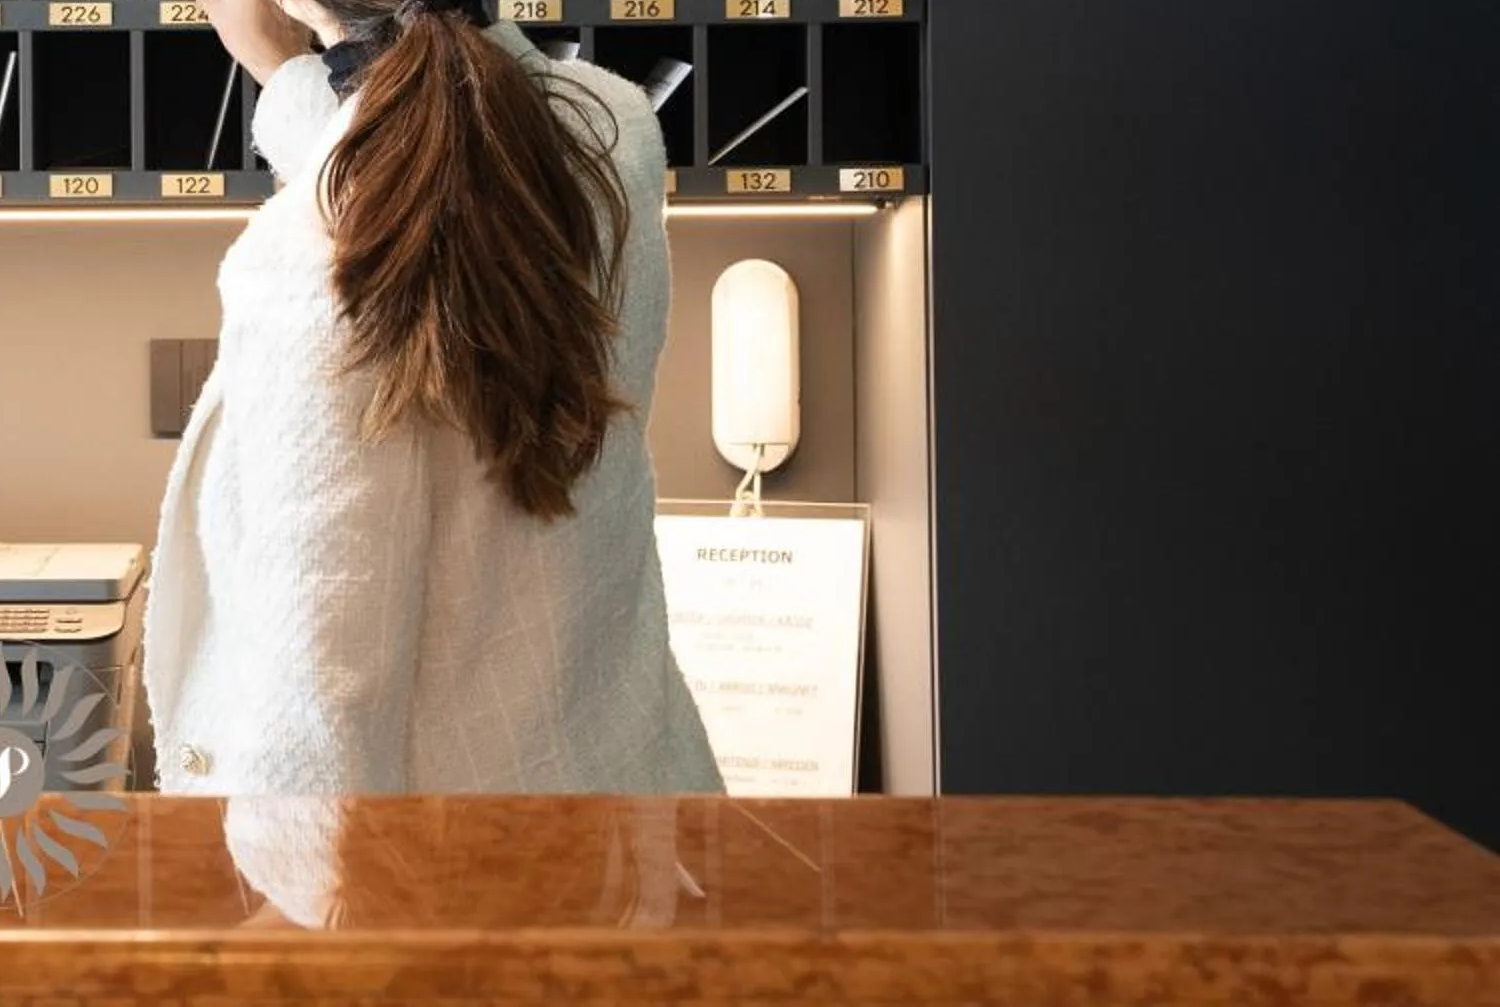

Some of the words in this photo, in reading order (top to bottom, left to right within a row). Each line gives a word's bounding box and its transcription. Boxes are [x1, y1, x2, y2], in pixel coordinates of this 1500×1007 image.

[62, 6, 100, 24] 226
[513, 2, 547, 18] 218
[624, 1, 660, 17] 216
[739, 0, 776, 16] 214
[63, 178, 99, 194] 120
[176, 178, 210, 194] 122
[741, 173, 777, 189] 132
[854, 171, 889, 188] 210
[697, 548, 794, 564] RECEPTION
